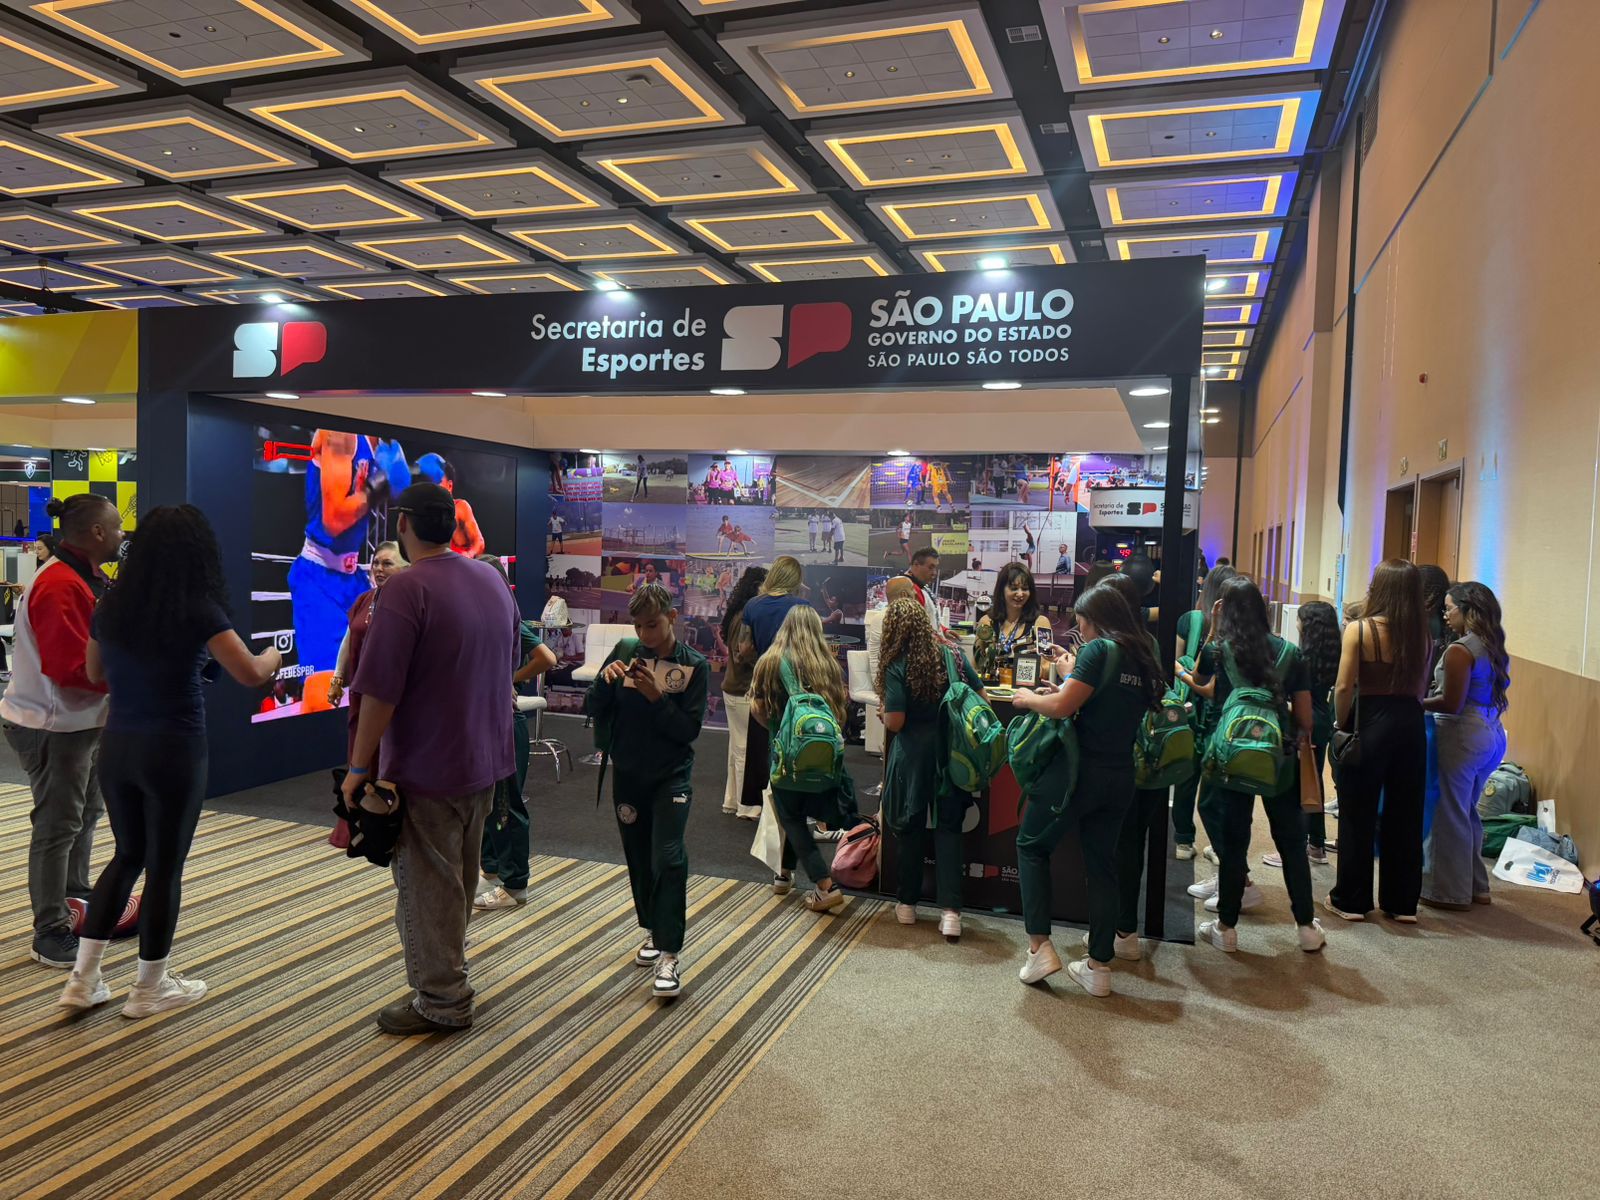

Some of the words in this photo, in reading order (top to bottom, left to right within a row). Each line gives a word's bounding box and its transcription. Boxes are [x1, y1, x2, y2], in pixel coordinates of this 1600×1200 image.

[530, 311, 664, 340] Secretaria
[672, 307, 707, 337] de
[869, 289, 943, 328] SÃO
[951, 288, 1074, 324] PAULO
[867, 329, 958, 346] GOVERNO
[964, 327, 992, 343] DO
[998, 324, 1072, 342] ESTADO
[581, 347, 705, 379] Esportes
[867, 352, 901, 368] SÃO
[907, 352, 960, 367] PAULO
[966, 348, 1002, 365] SÃO
[1009, 347, 1070, 363] TODOS
